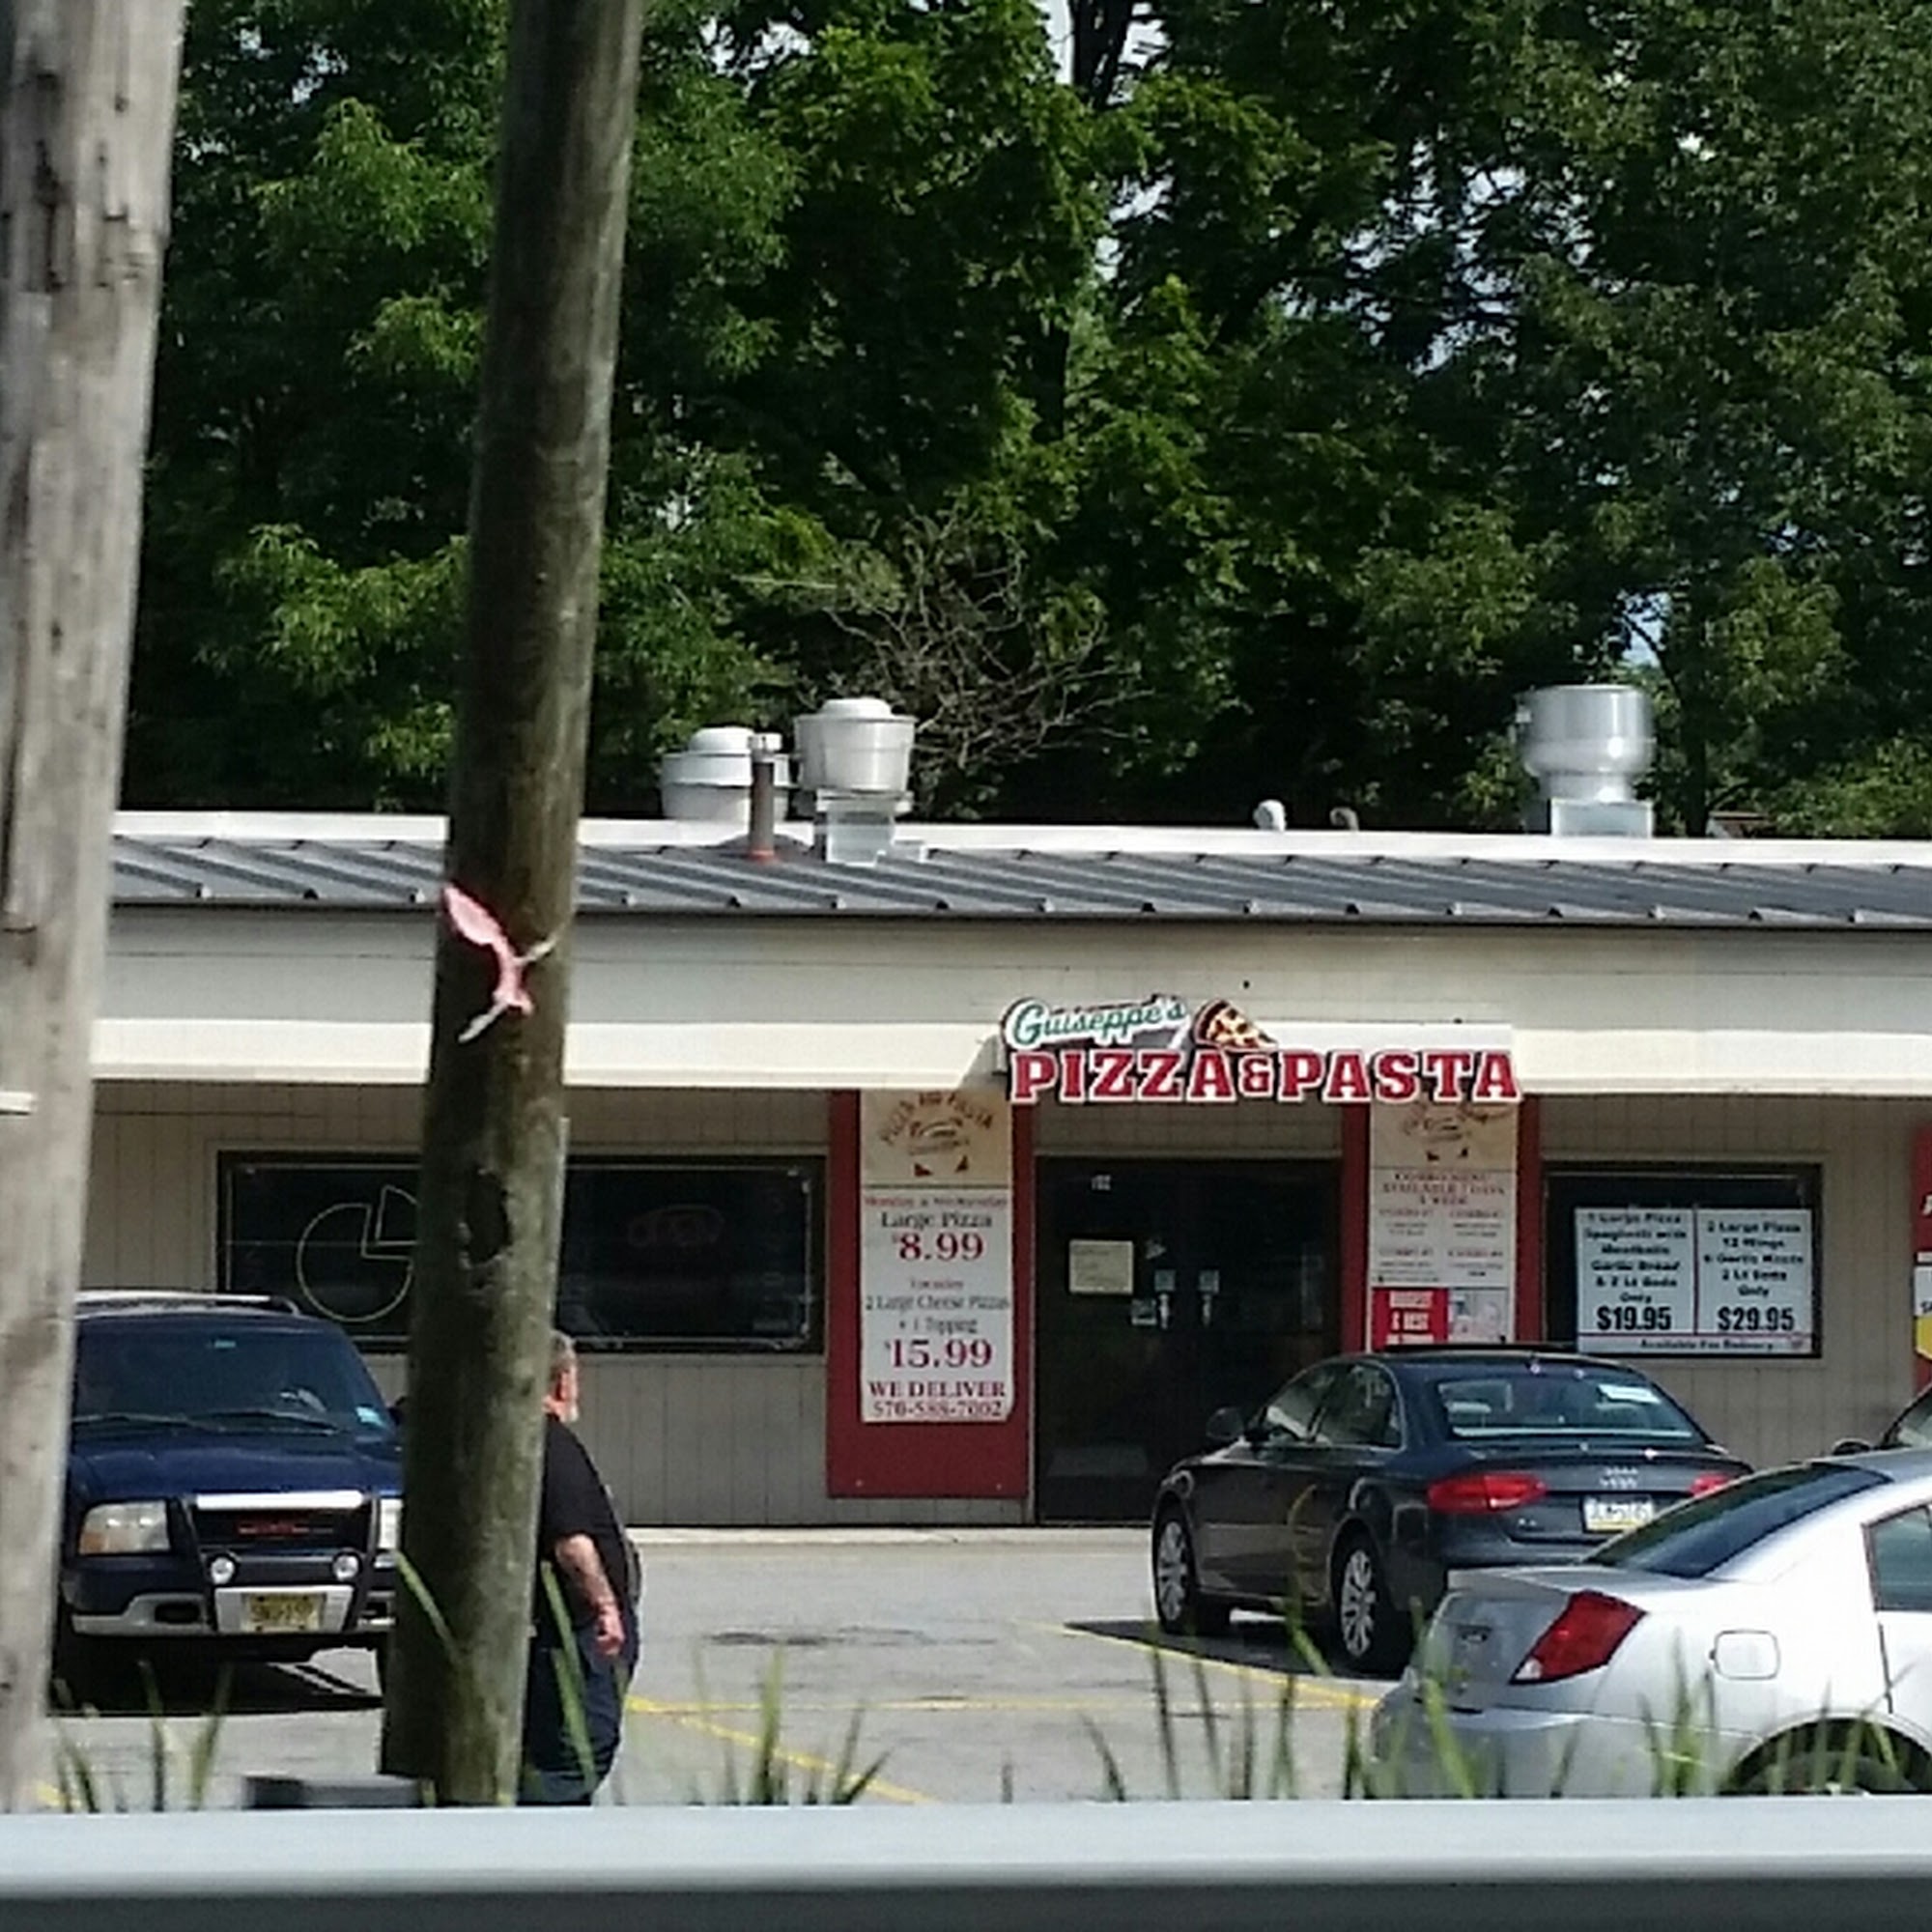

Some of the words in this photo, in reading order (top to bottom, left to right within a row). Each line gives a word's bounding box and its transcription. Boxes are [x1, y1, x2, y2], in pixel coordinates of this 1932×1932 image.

[1010, 999, 1187, 1041] Guiseppe's
[881, 1211, 934, 1232] Large
[942, 1210, 992, 1228] Pizza
[1719, 1221, 1758, 1235] Large
[1743, 1237, 1785, 1250] Wings
[917, 1294, 966, 1310] Cheese
[1596, 1305, 1672, 1331] $19.95
[1717, 1306, 1797, 1331] $29.95
[868, 1380, 903, 1398] WE
[908, 1380, 1006, 1398] DELIVER
